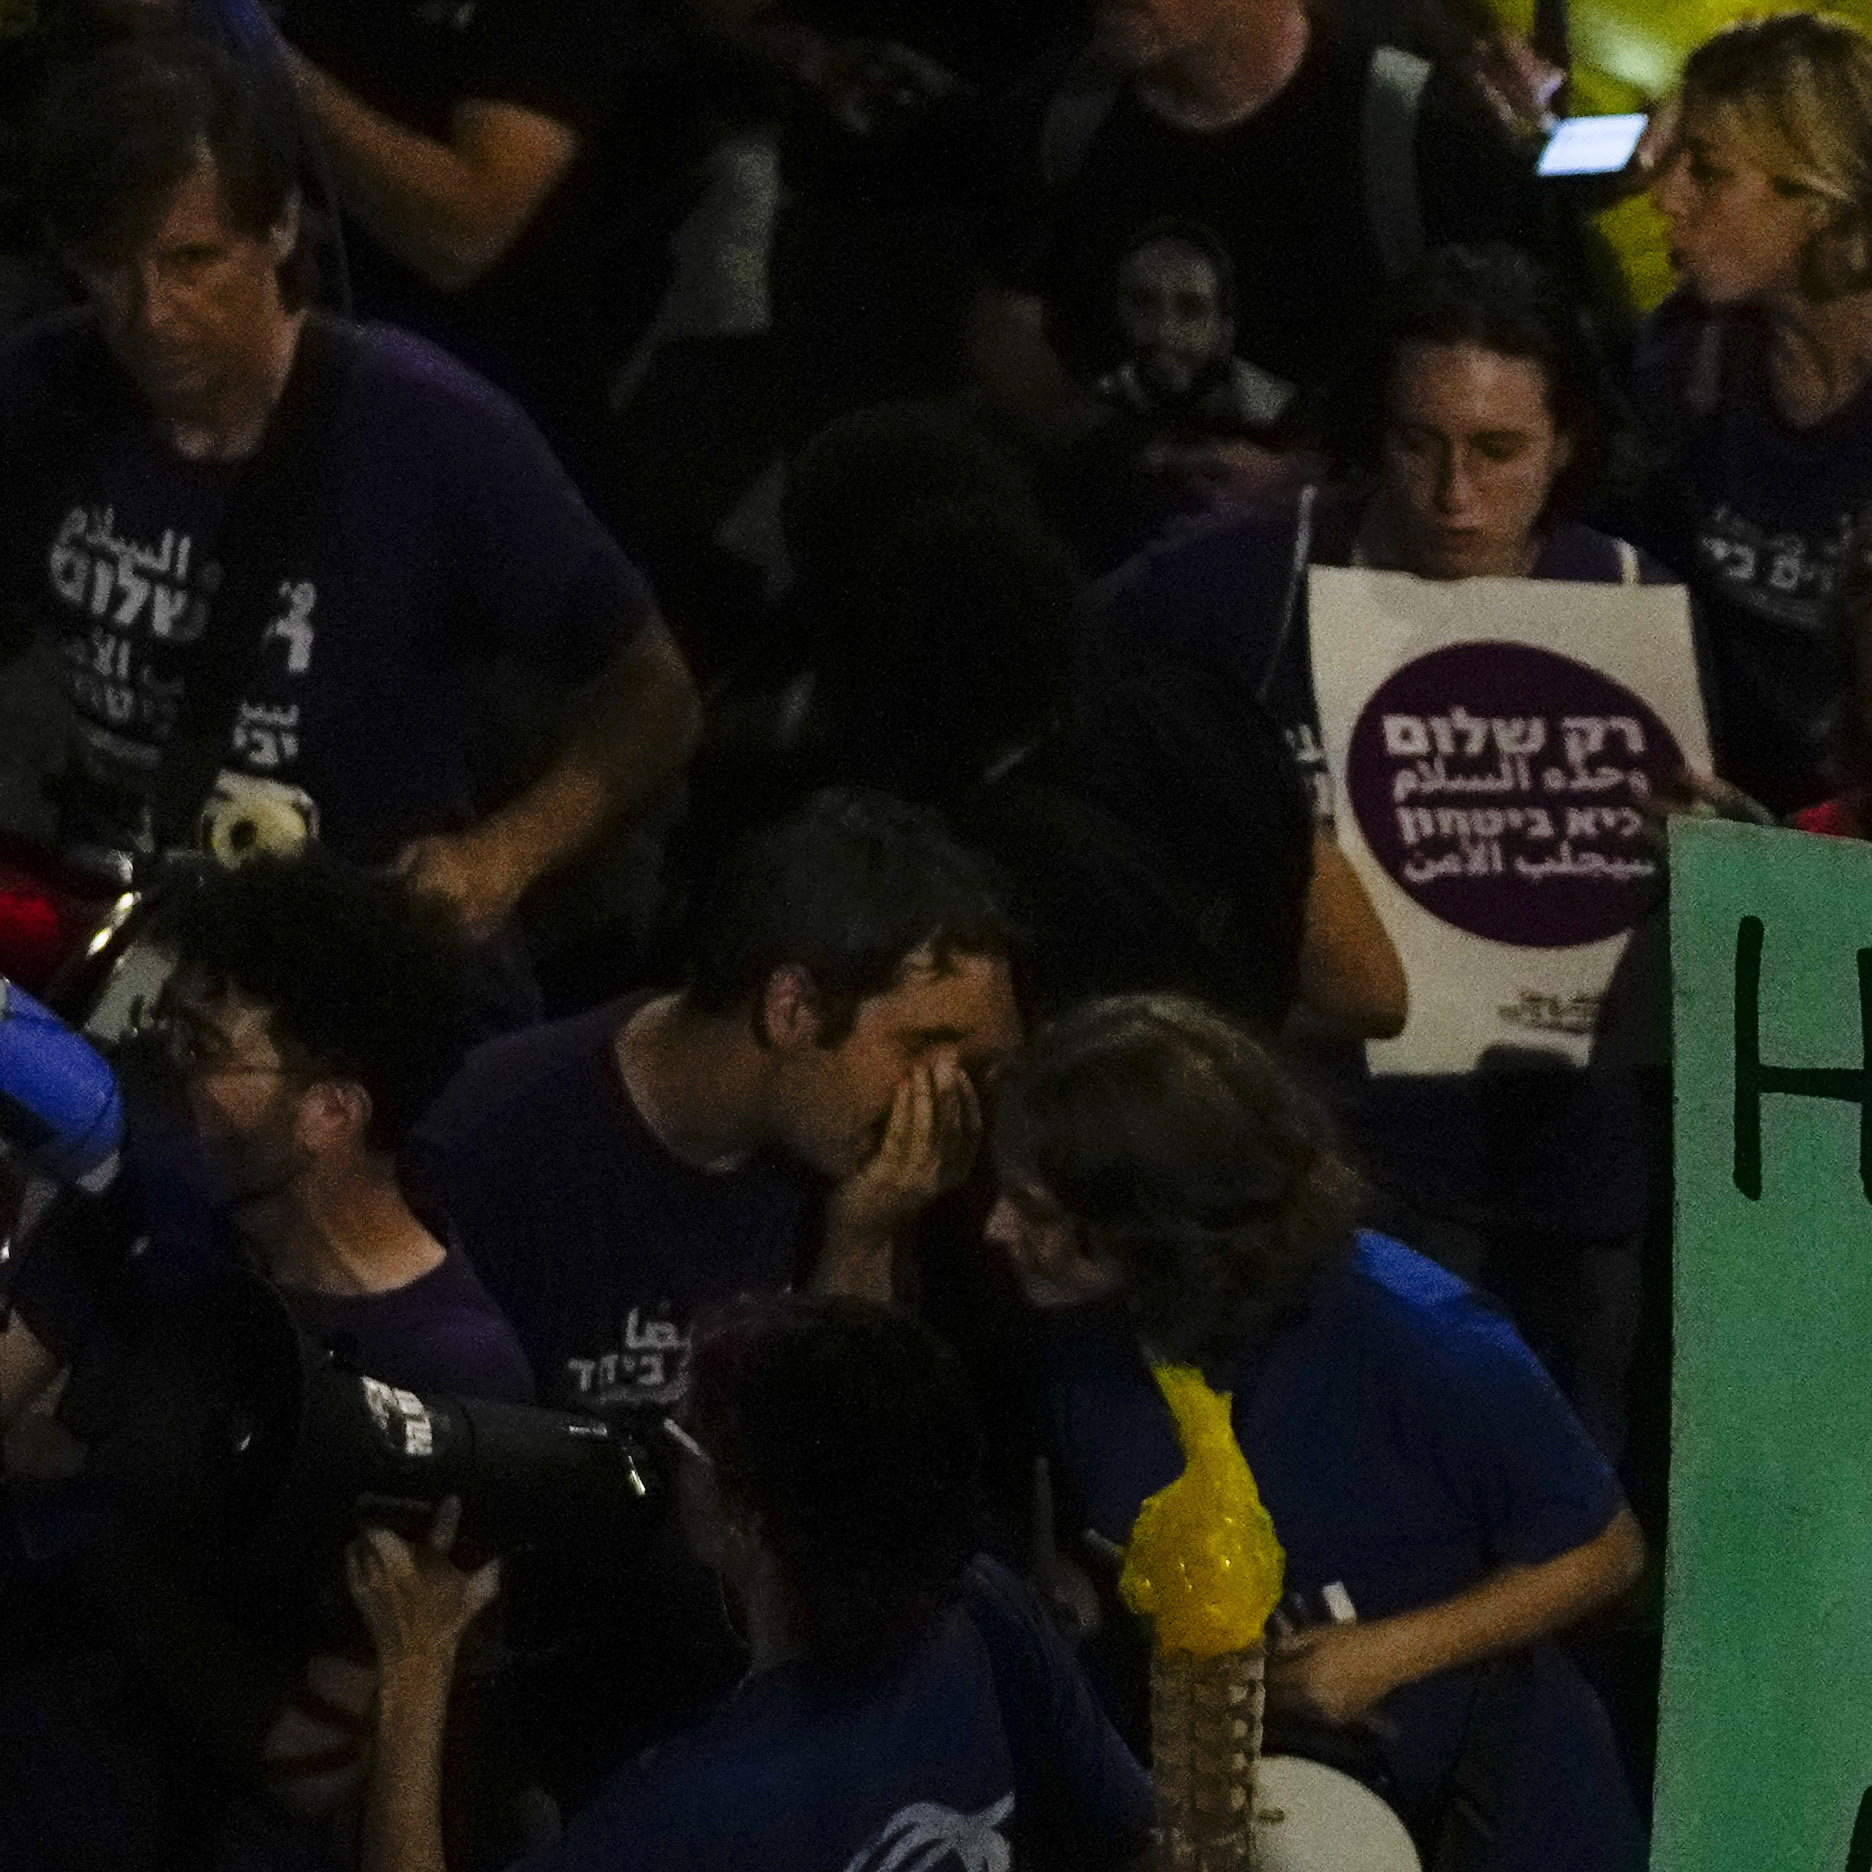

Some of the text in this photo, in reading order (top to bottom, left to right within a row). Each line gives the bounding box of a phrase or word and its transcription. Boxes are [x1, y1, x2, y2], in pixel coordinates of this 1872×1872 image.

[1381, 707, 1648, 764] רק שלום
[1395, 804, 1556, 846] ביטחון
